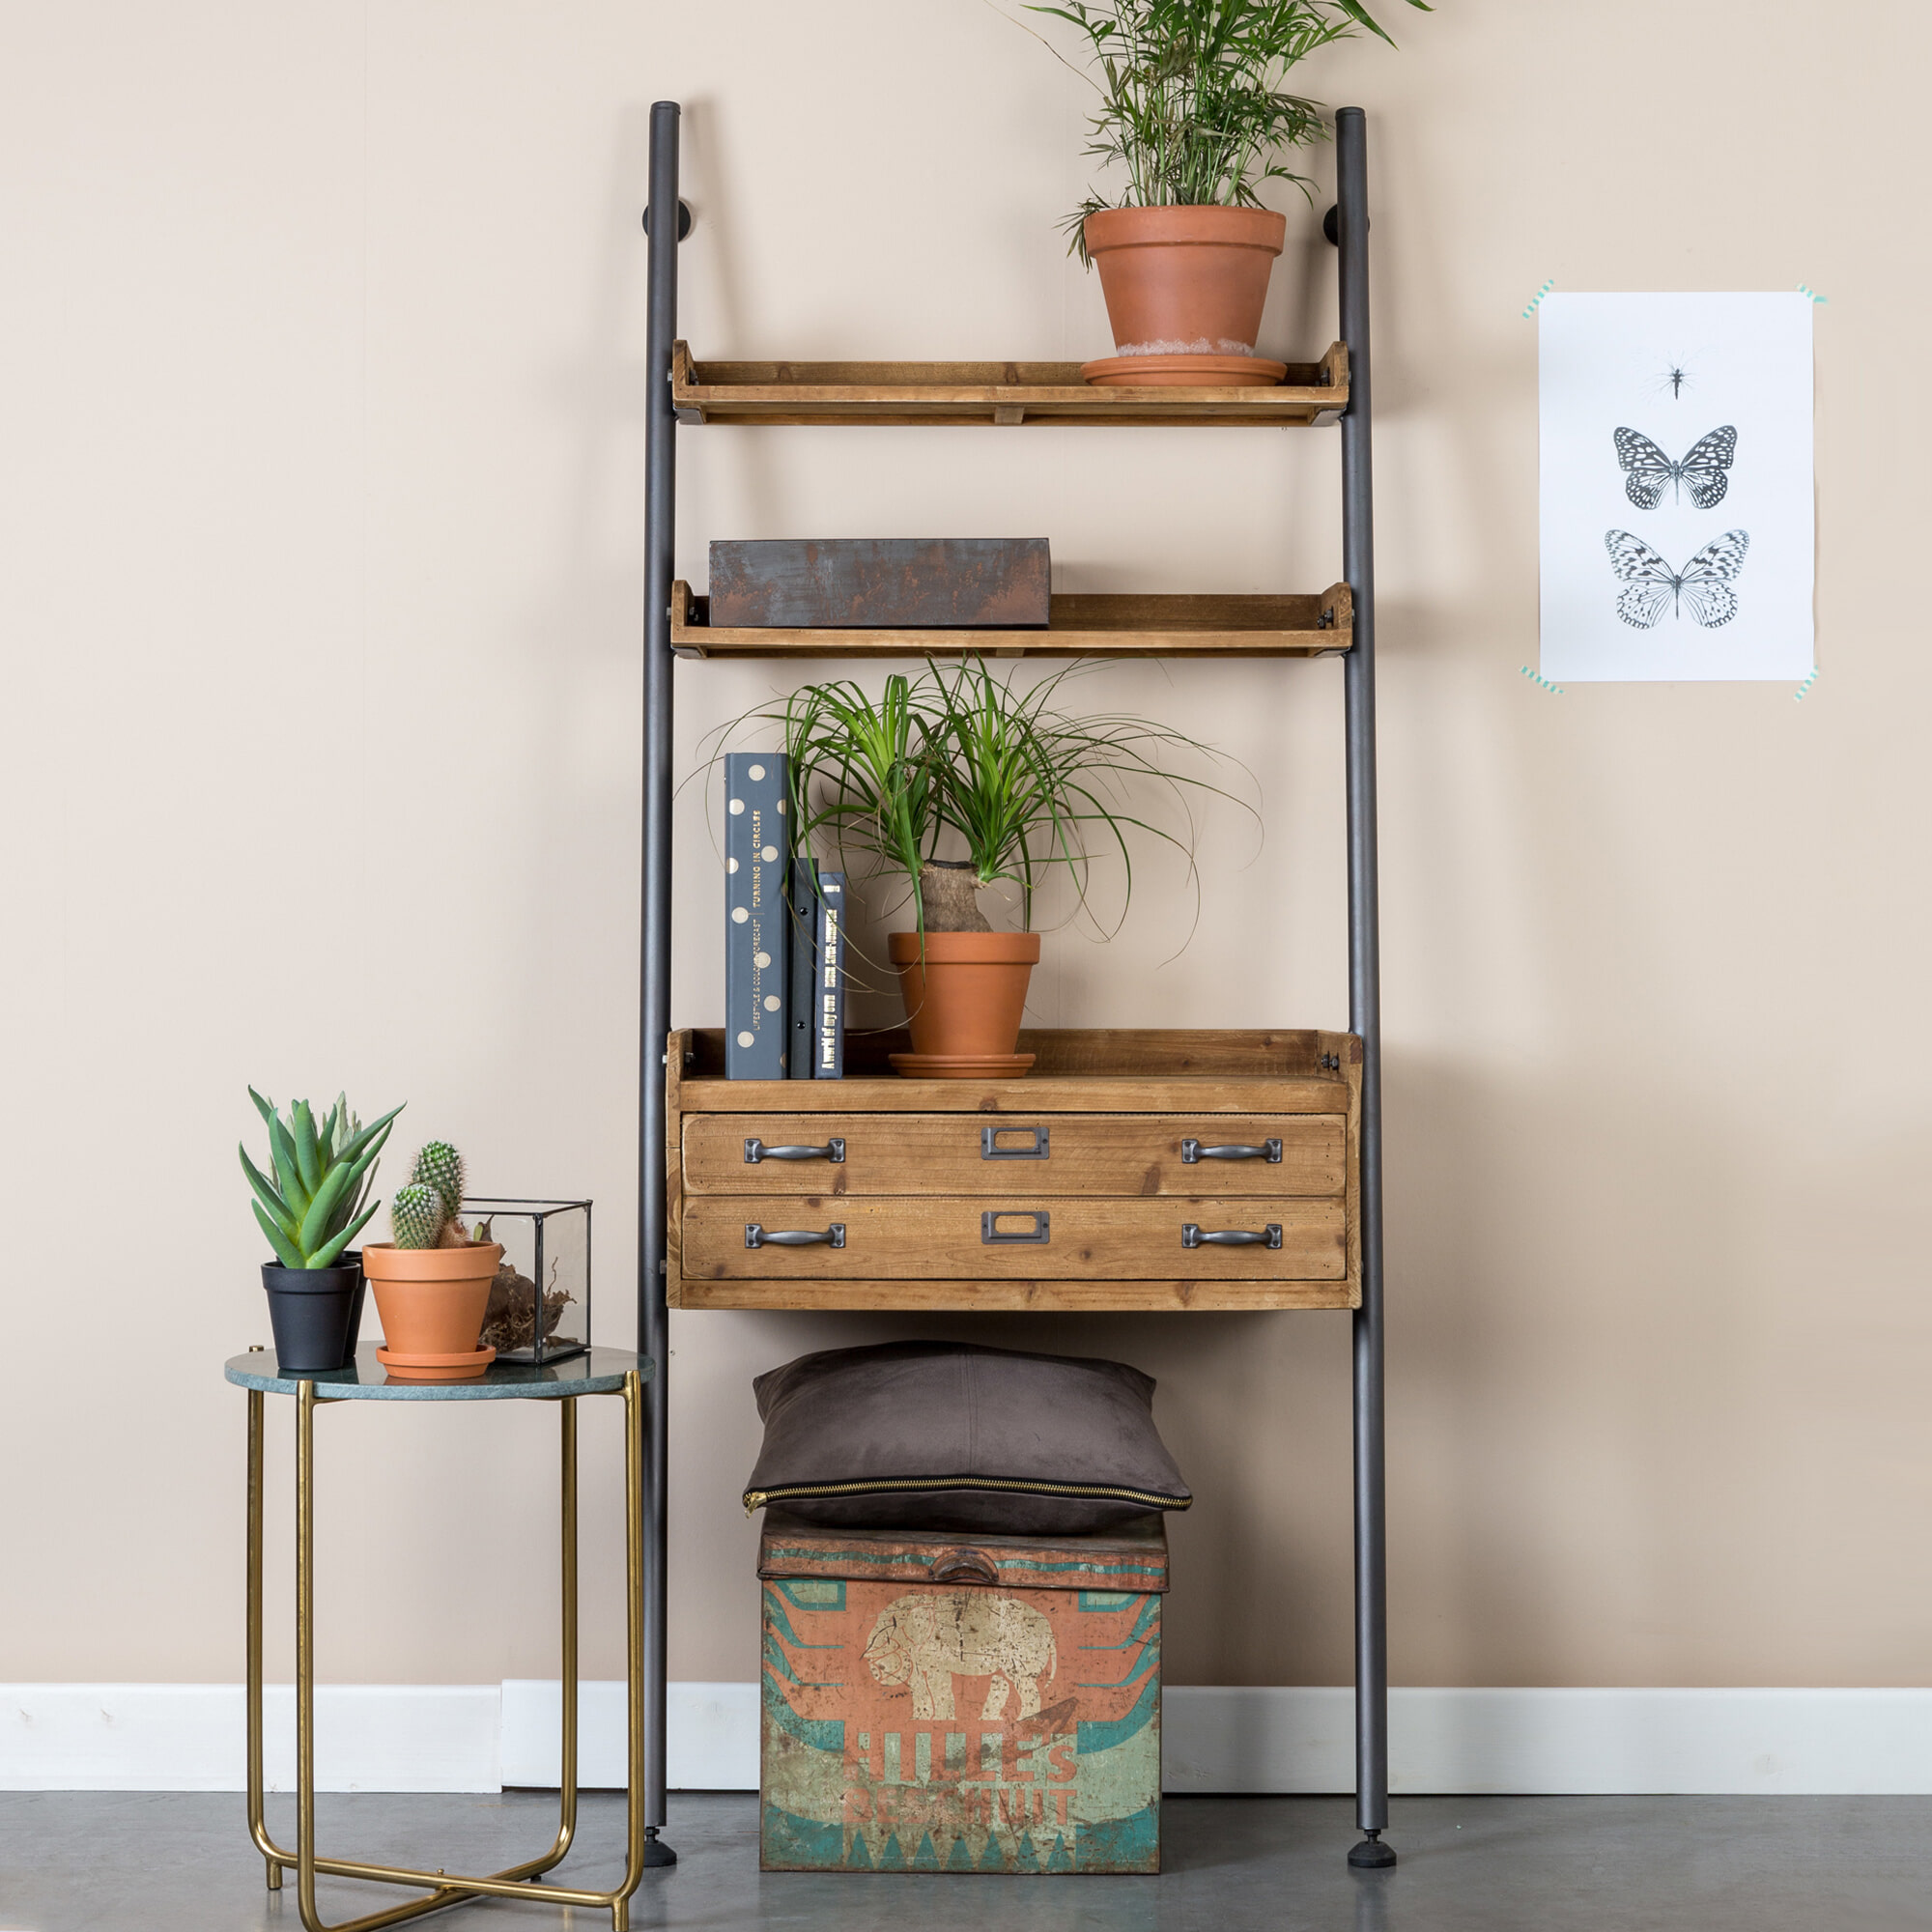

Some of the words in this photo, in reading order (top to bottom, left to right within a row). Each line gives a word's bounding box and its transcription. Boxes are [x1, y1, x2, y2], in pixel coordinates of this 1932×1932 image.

[753, 810, 761, 849] CIRCLES
[753, 852, 761, 863] IN
[753, 867, 761, 908] TURNING
[823, 995, 835, 1012] own
[823, 1013, 837, 1026] my
[821, 1027, 835, 1037] of
[821, 1037, 835, 1063] world
